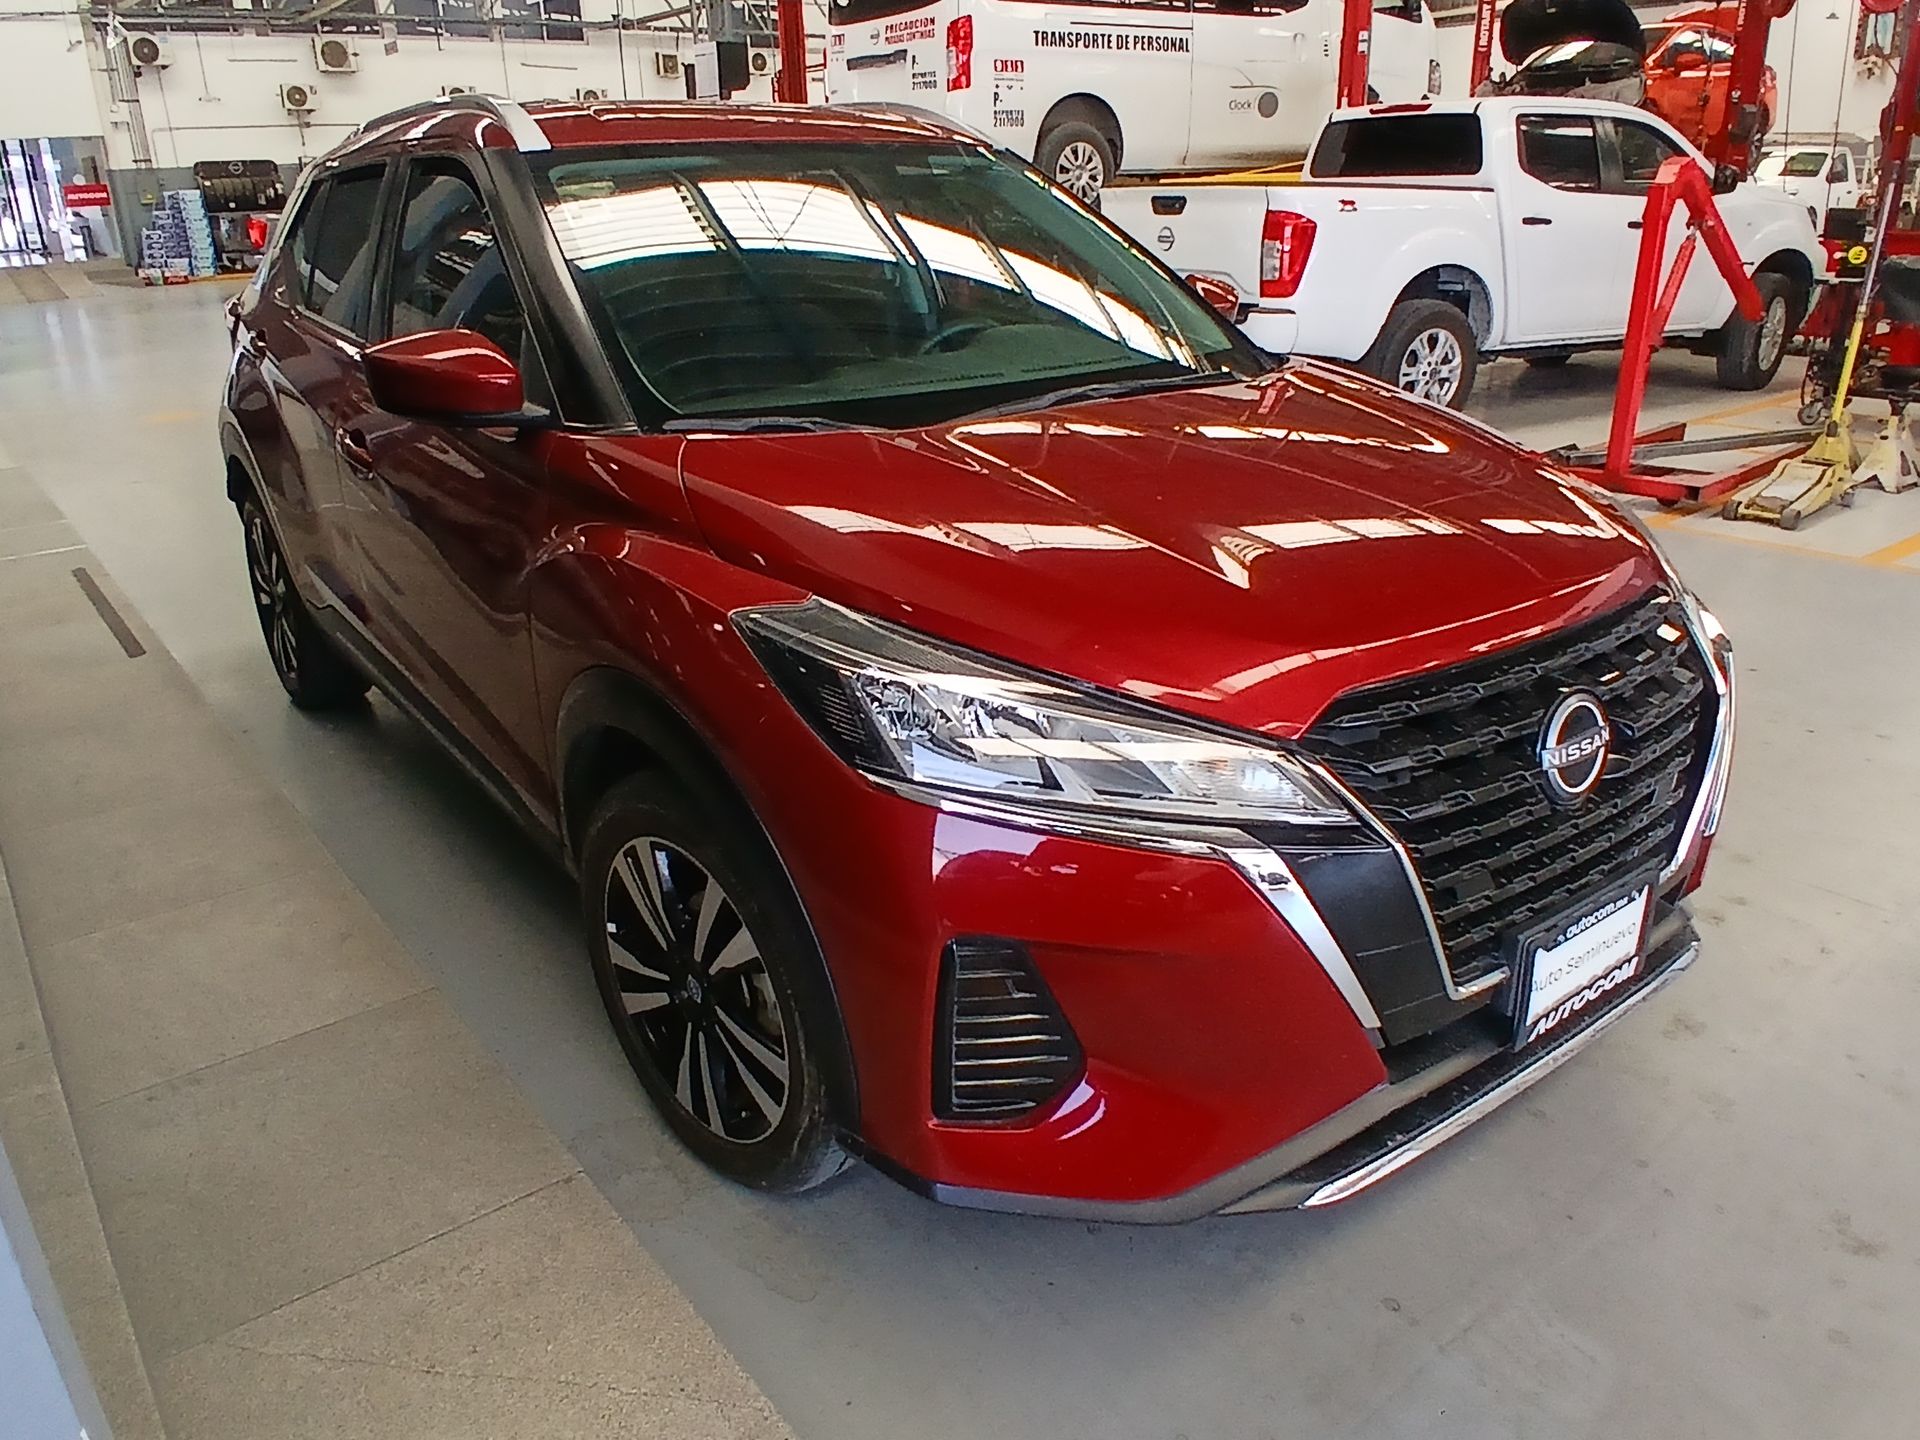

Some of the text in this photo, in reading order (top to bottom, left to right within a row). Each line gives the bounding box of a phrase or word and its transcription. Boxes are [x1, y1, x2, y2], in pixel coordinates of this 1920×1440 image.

[1033, 30, 1190, 53] TRANSPORTE DE PERSONAL
[1547, 726, 1610, 766] NISSAN
[1532, 921, 1637, 993] Auto Seminuevo
[1527, 956, 1639, 1042] AUTOCOM
